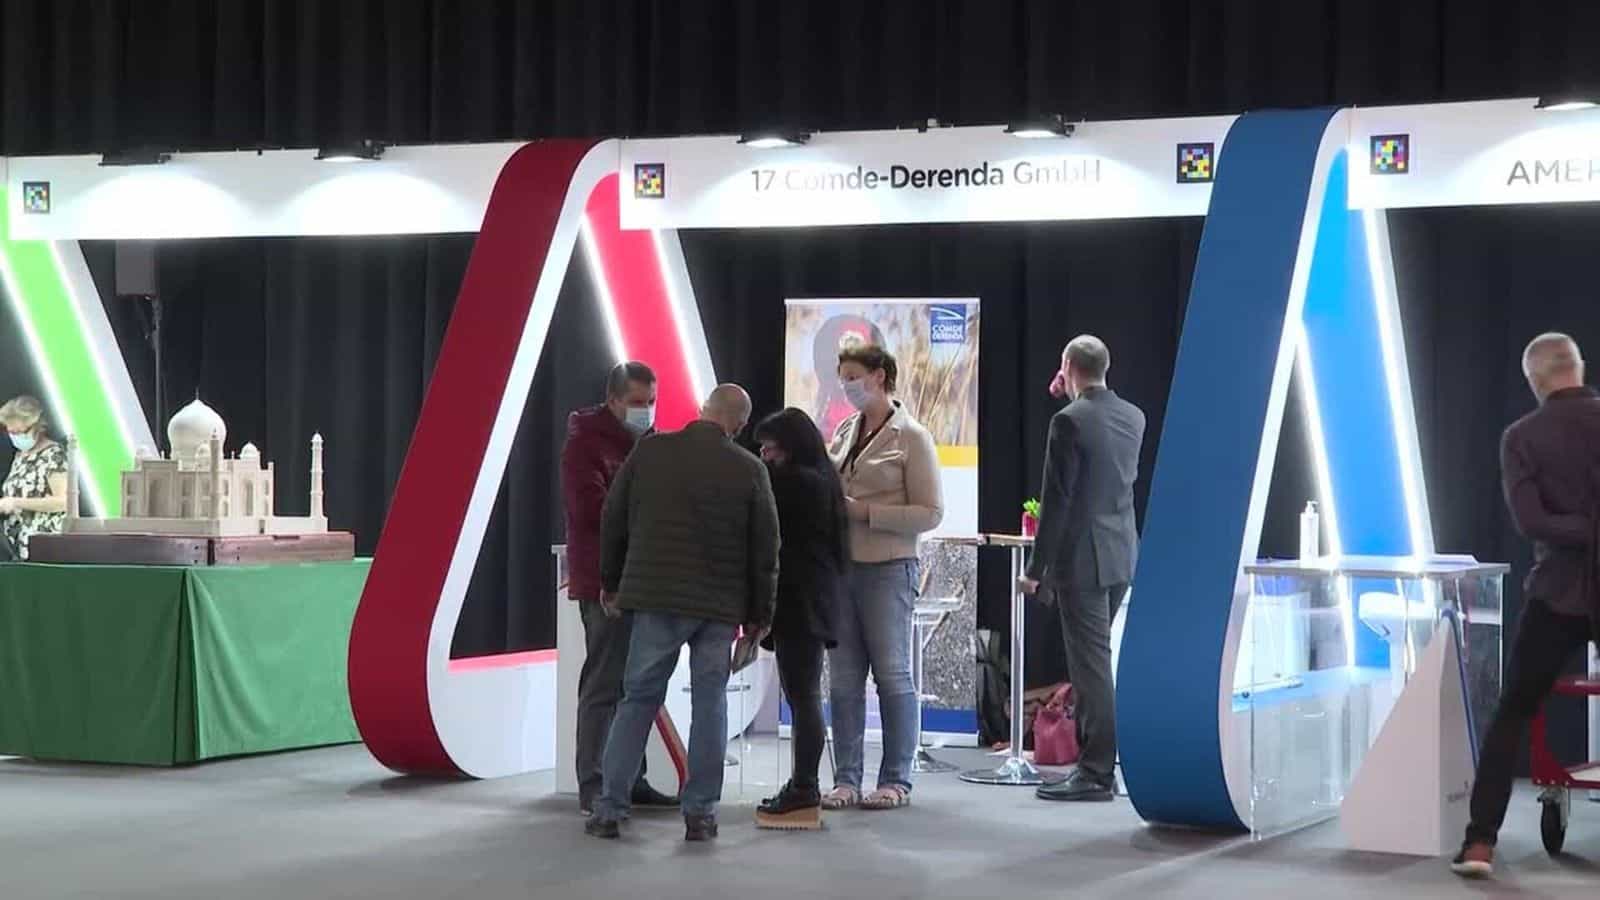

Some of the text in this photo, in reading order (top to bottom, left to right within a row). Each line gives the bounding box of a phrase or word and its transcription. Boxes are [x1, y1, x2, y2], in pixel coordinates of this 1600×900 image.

[751, 159, 1101, 191] 17 Comde-Derenda GmbH
